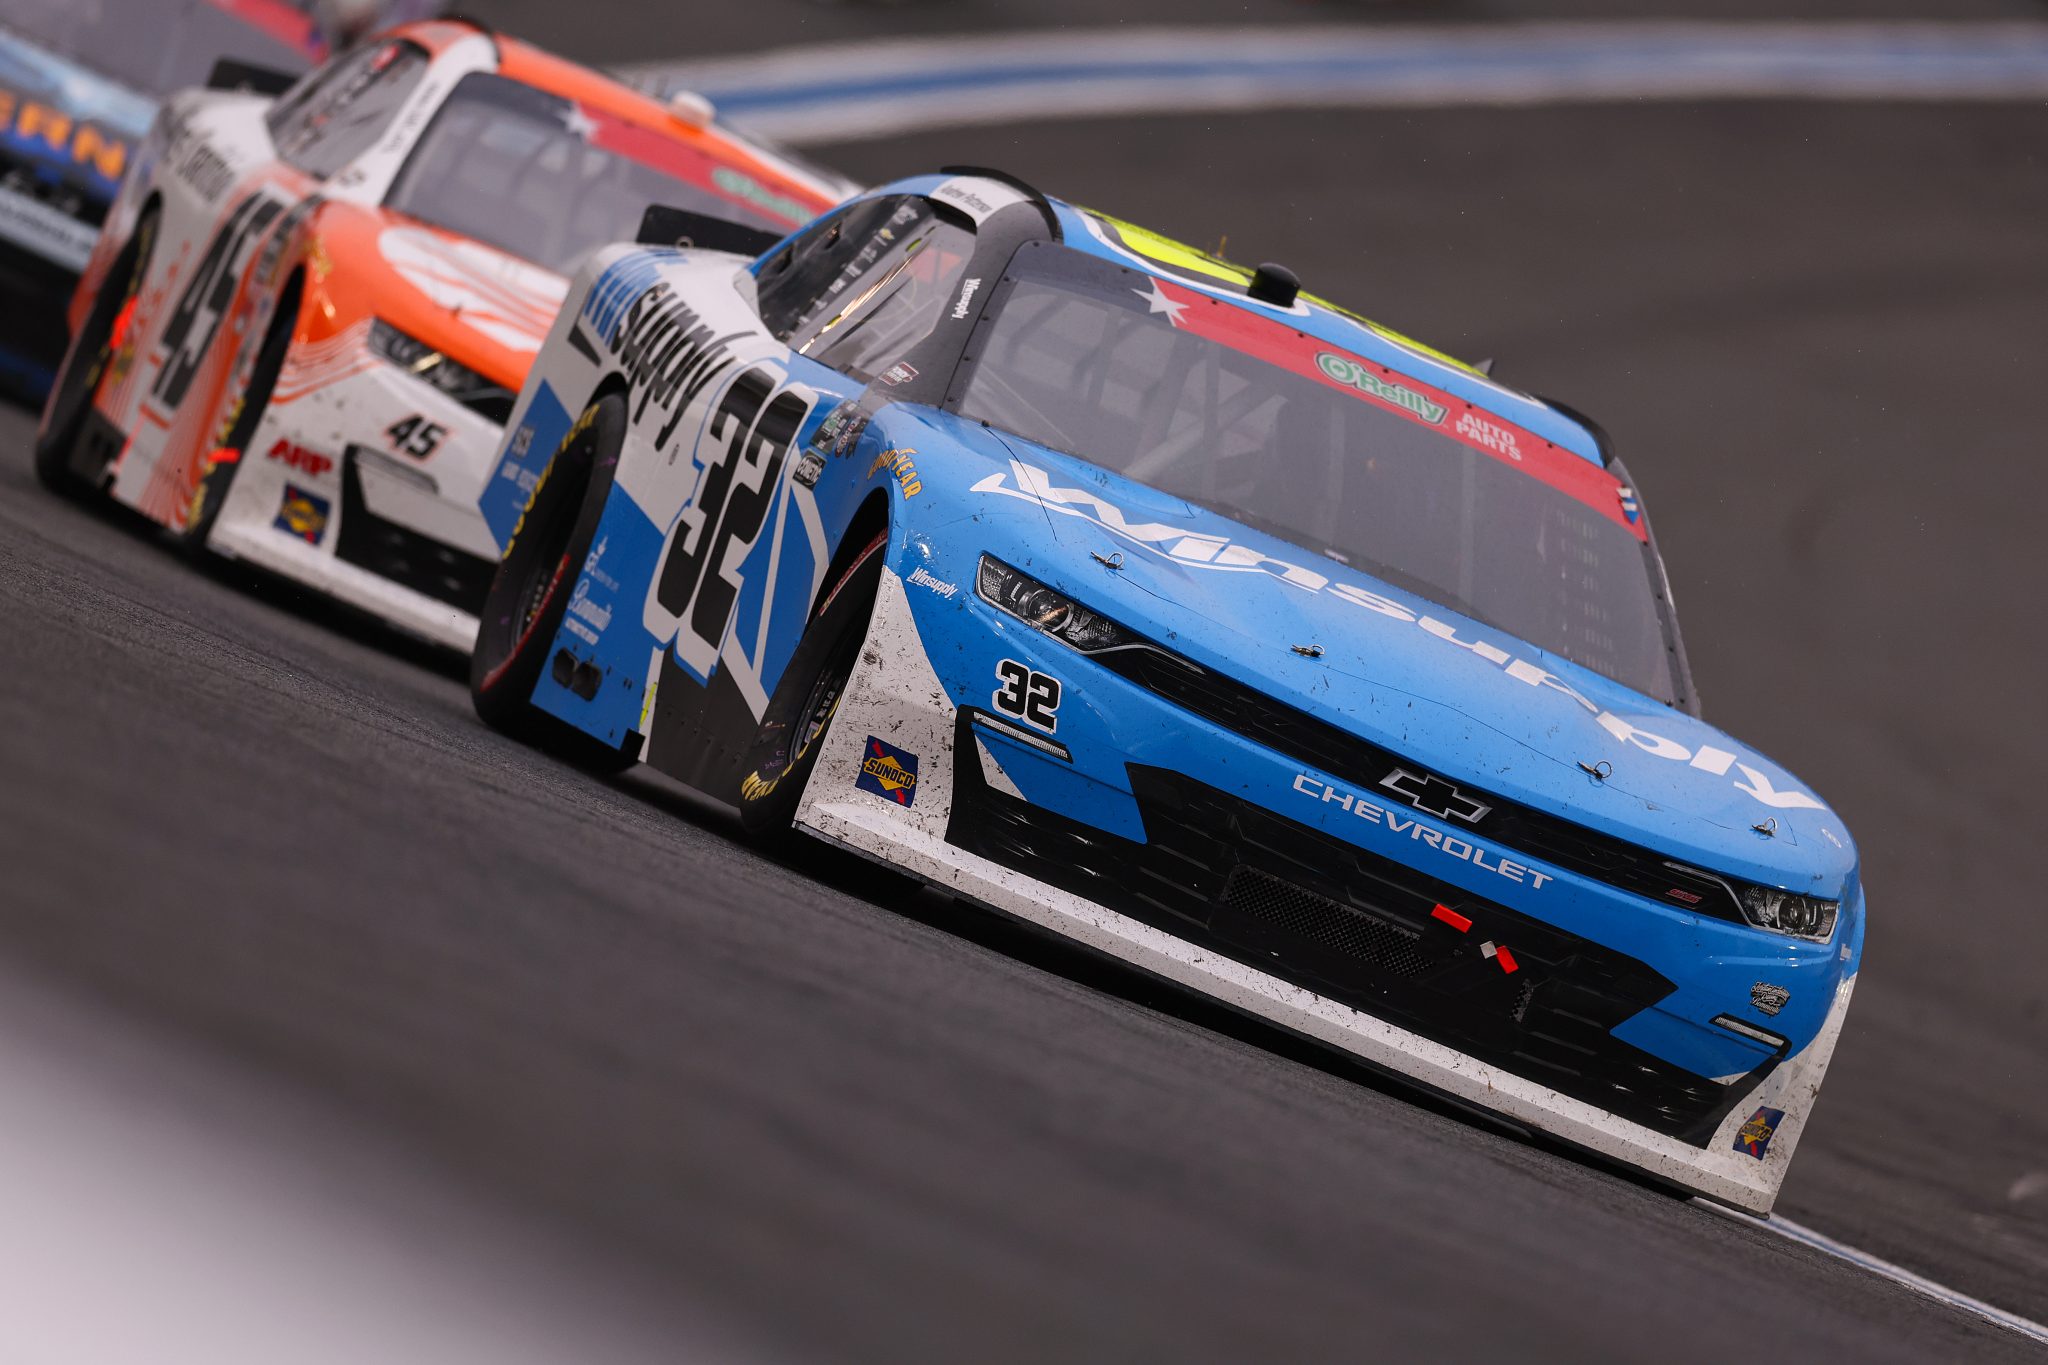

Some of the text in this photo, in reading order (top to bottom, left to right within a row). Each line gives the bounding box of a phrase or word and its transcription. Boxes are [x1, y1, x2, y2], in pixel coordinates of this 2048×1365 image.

[1315, 352, 1449, 425] O'Reilly
[385, 412, 449, 461] 45
[1455, 420, 1522, 461] PARTS
[1462, 412, 1516, 446] AUTO
[652, 361, 815, 665] 32
[906, 567, 959, 600] Winsupply
[969, 458, 1827, 811] Winsupply
[992, 658, 1062, 735] 32
[865, 758, 914, 788] SUNOCO
[1292, 774, 1554, 889] CHEVROLET
